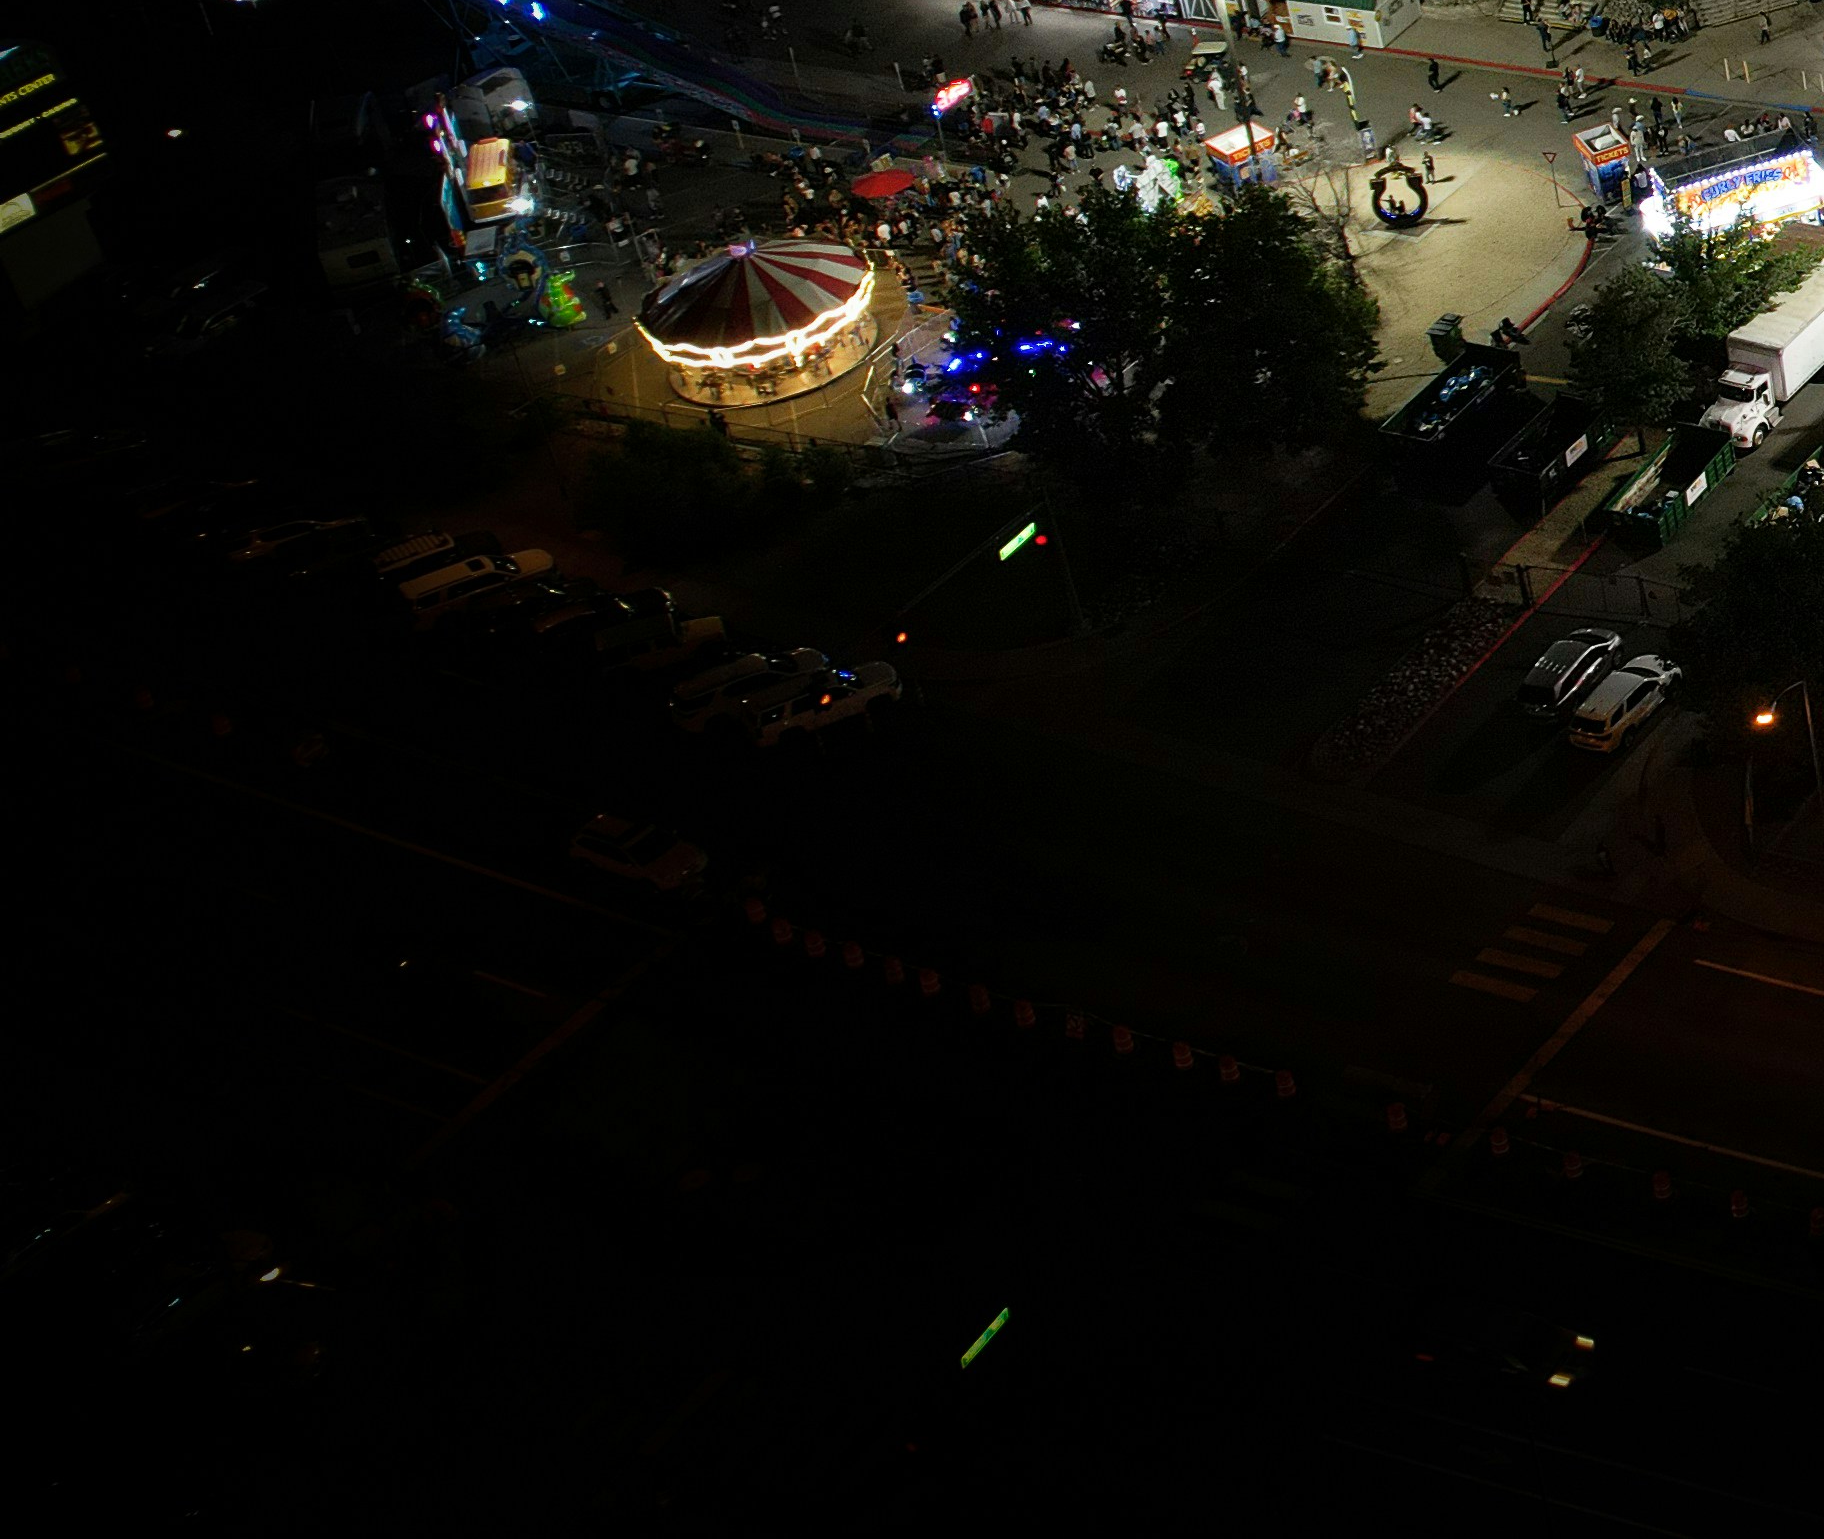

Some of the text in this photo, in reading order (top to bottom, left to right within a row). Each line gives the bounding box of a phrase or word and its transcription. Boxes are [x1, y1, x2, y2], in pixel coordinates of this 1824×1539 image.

[1597, 147, 1629, 162] TICKETS
[1701, 167, 1783, 203] CURLY FRIES
